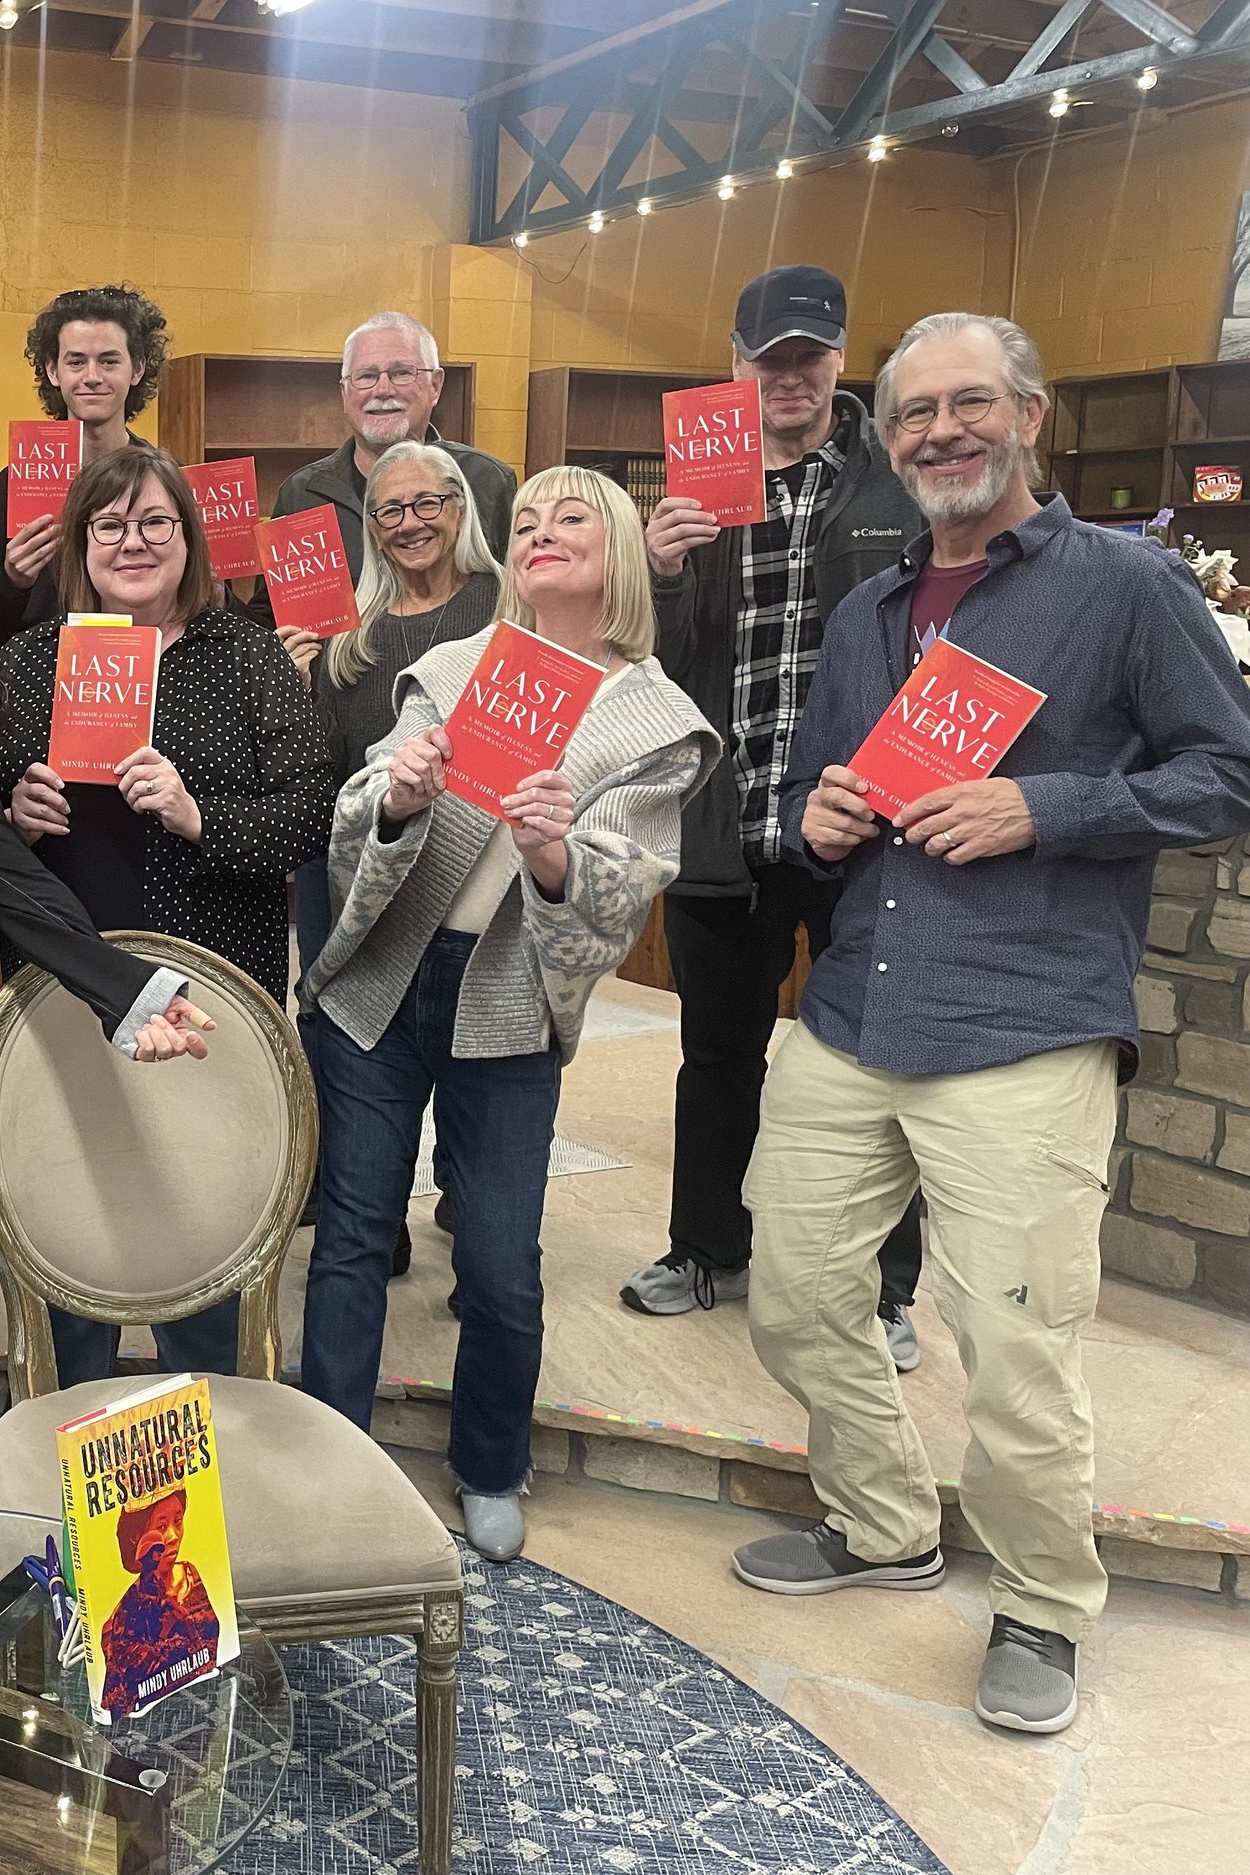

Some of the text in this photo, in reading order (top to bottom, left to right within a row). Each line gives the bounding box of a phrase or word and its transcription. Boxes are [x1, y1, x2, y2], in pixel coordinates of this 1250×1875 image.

[678, 408, 744, 437] LAST
[18, 442, 68, 459] LAST
[669, 431, 758, 462] NERVE
[10, 463, 77, 480] NERVE
[192, 481, 244, 504] LAST
[202, 500, 257, 524] ERVE
[272, 531, 326, 562] LAST
[860, 528, 902, 537] Columbia
[267, 550, 344, 586] NERVE
[72, 654, 140, 677] LAST
[59, 681, 149, 704] NERVE
[491, 659, 571, 712] LAST
[466, 680, 568, 748] NERVE
[920, 676, 1005, 732] LAST
[892, 695, 998, 768] NERVE
[61, 760, 90, 769] MINDY
[81, 1400, 208, 1479] UNNATURAL
[86, 1434, 211, 1518] RESOURCES
[61, 1458, 94, 1664] UNNATURAL RESOURCES MINDY UHRLAUB
[138, 1648, 210, 1699] MINDY UHRLAUB
